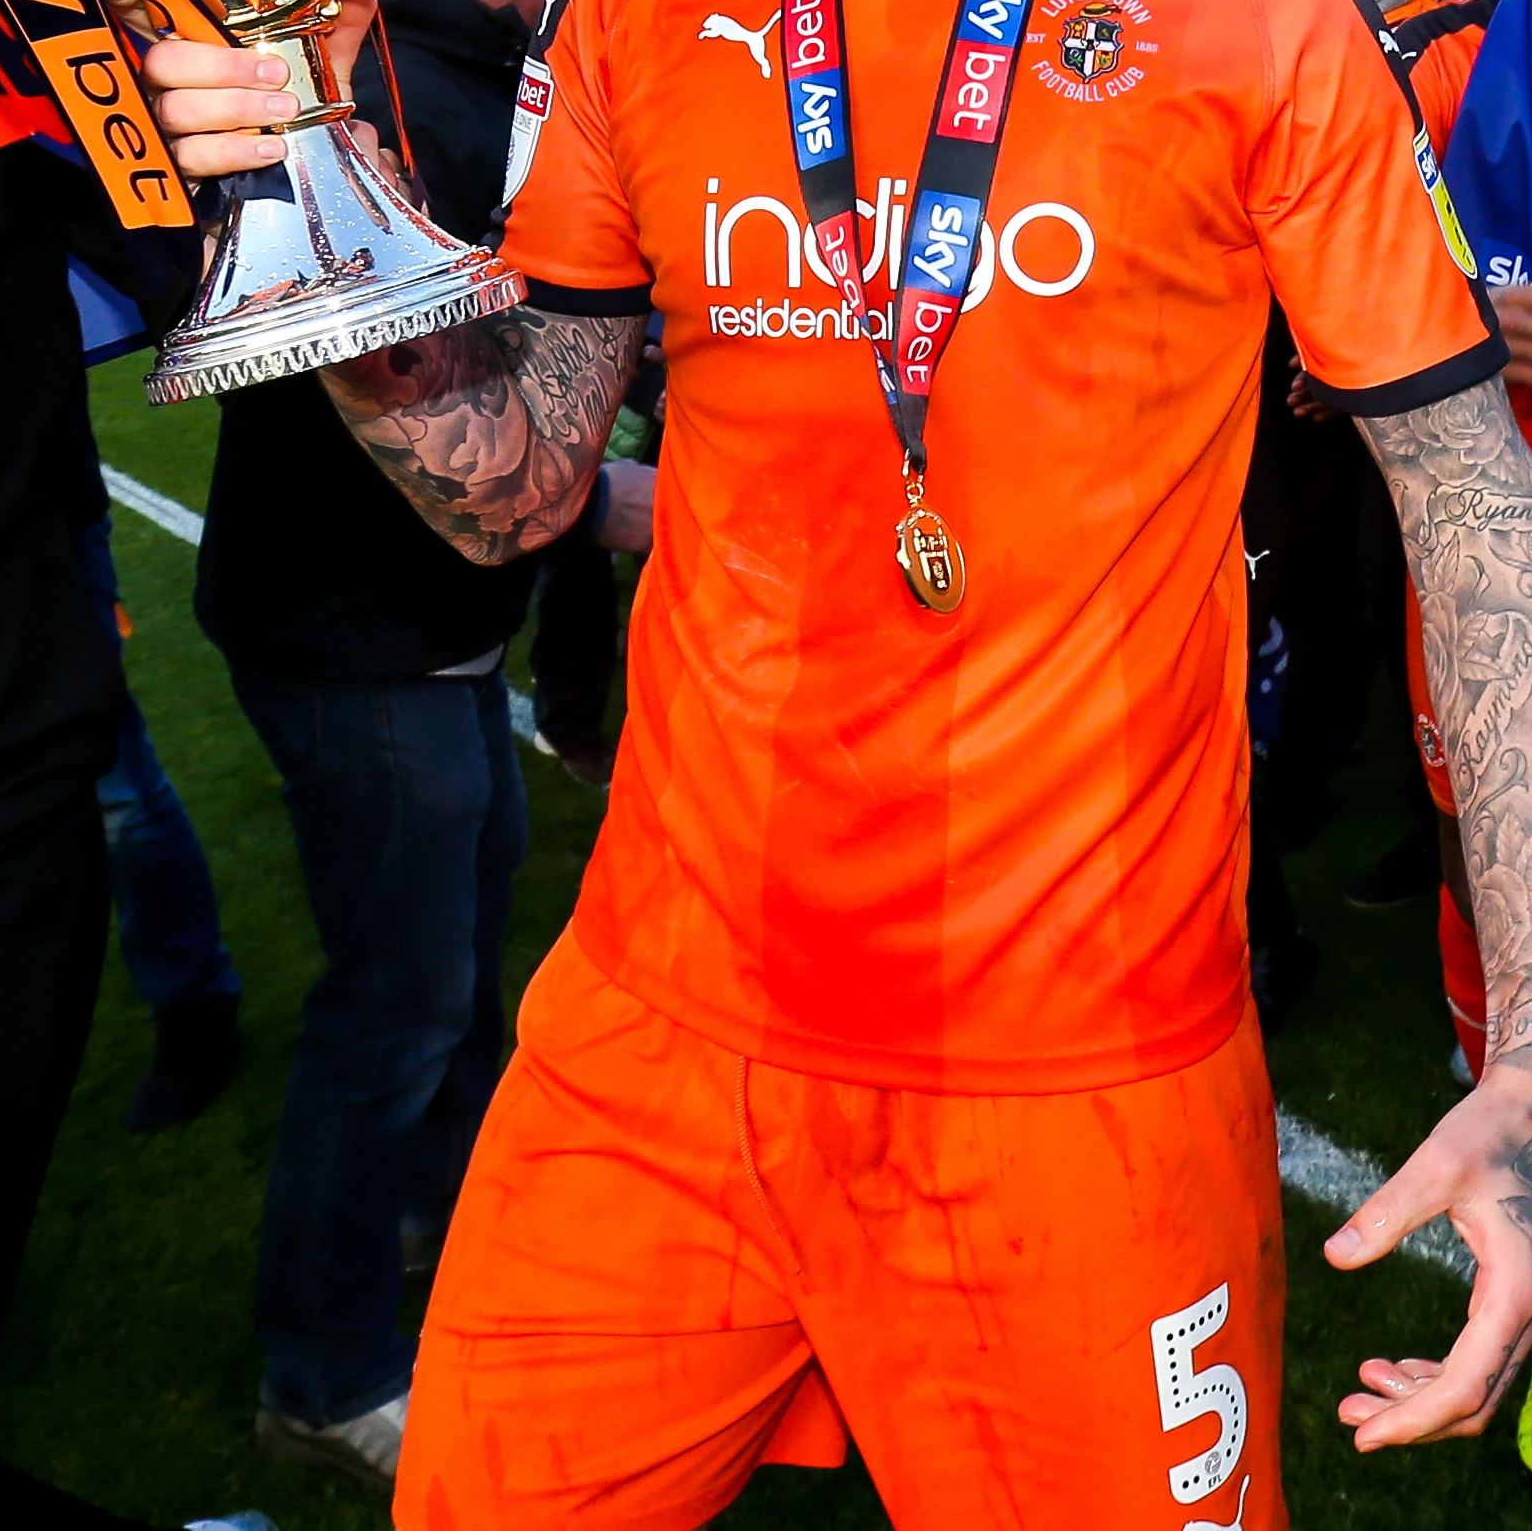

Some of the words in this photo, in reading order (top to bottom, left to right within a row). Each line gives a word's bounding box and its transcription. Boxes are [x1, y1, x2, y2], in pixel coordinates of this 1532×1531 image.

[519, 78, 547, 108] bet
[797, 80, 838, 156] sky
[952, 51, 1006, 131] bet
[1030, 59, 1105, 104] FOOTBALL
[1104, 65, 1147, 100] CLUB
[66, 49, 170, 205] bet
[913, 203, 970, 288] sky
[906, 301, 954, 384] bet
[1444, 488, 1532, 533] Ryan
[1149, 1280, 1249, 1506] 5
